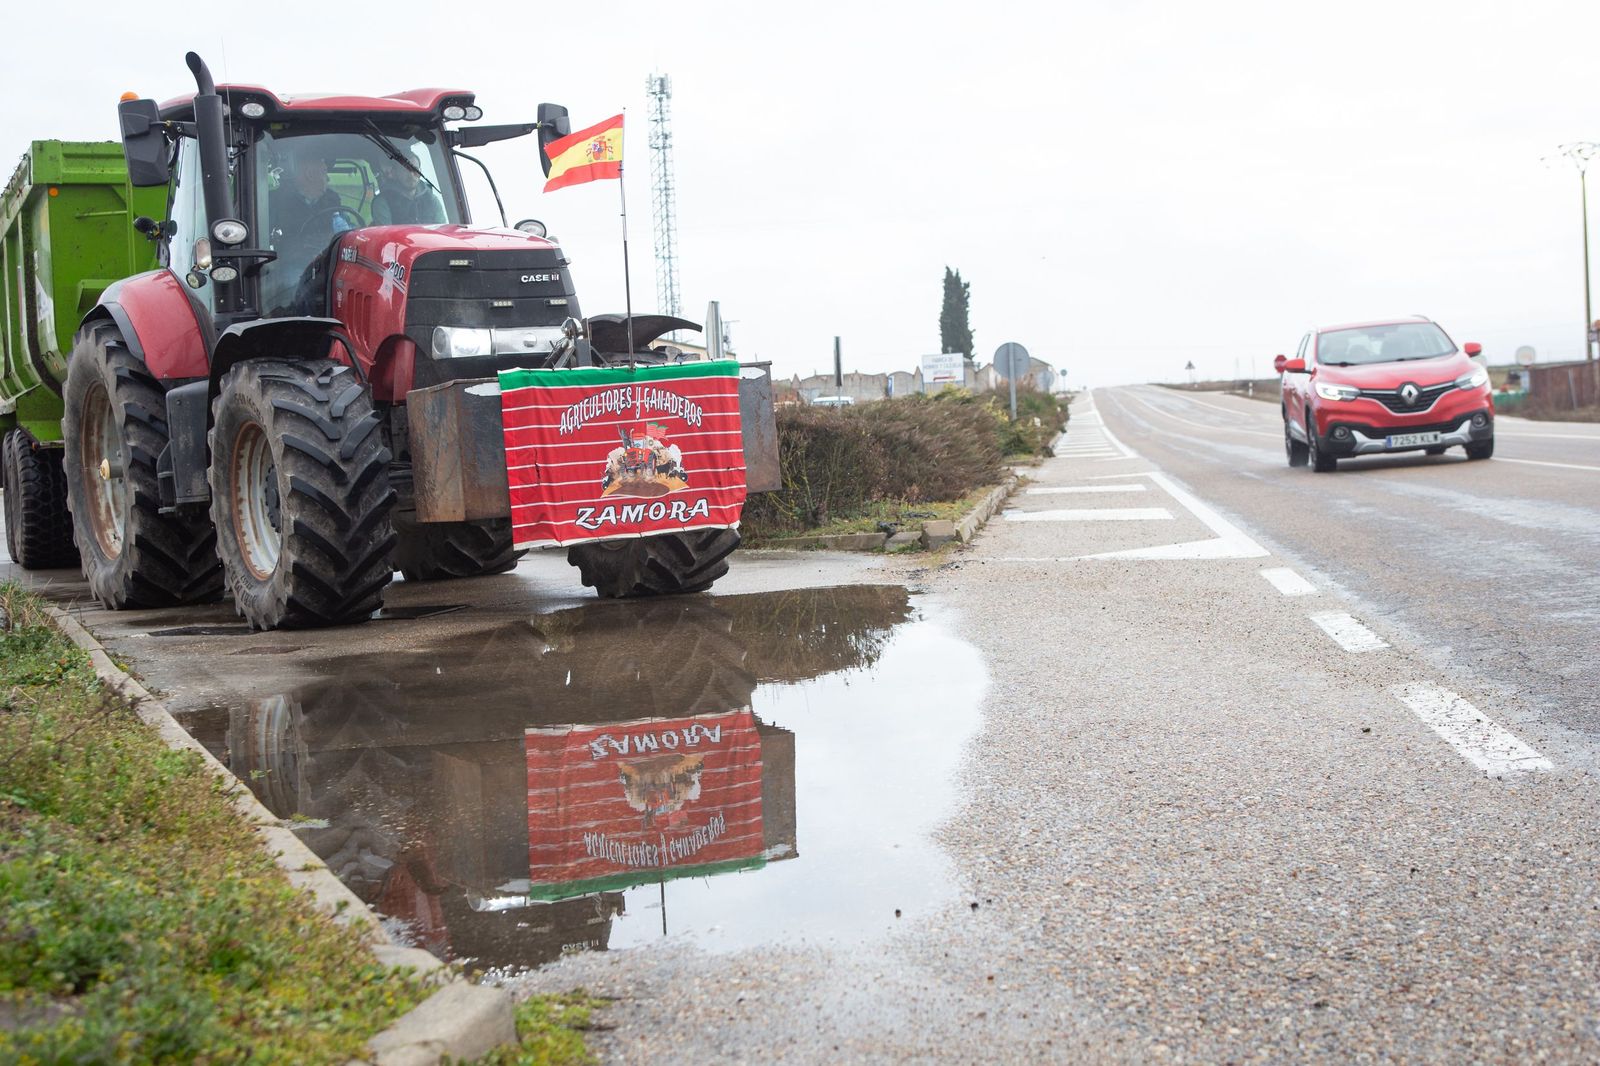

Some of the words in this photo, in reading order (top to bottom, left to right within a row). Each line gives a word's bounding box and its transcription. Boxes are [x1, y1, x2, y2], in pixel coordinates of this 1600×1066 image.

[389, 261, 405, 280] 200
[521, 274, 550, 283] CASE
[559, 386, 632, 436] AGRICULTORES
[643, 387, 703, 428] GANADEROS
[1393, 435, 1417, 445] 7252
[574, 498, 709, 530] ZAMORA
